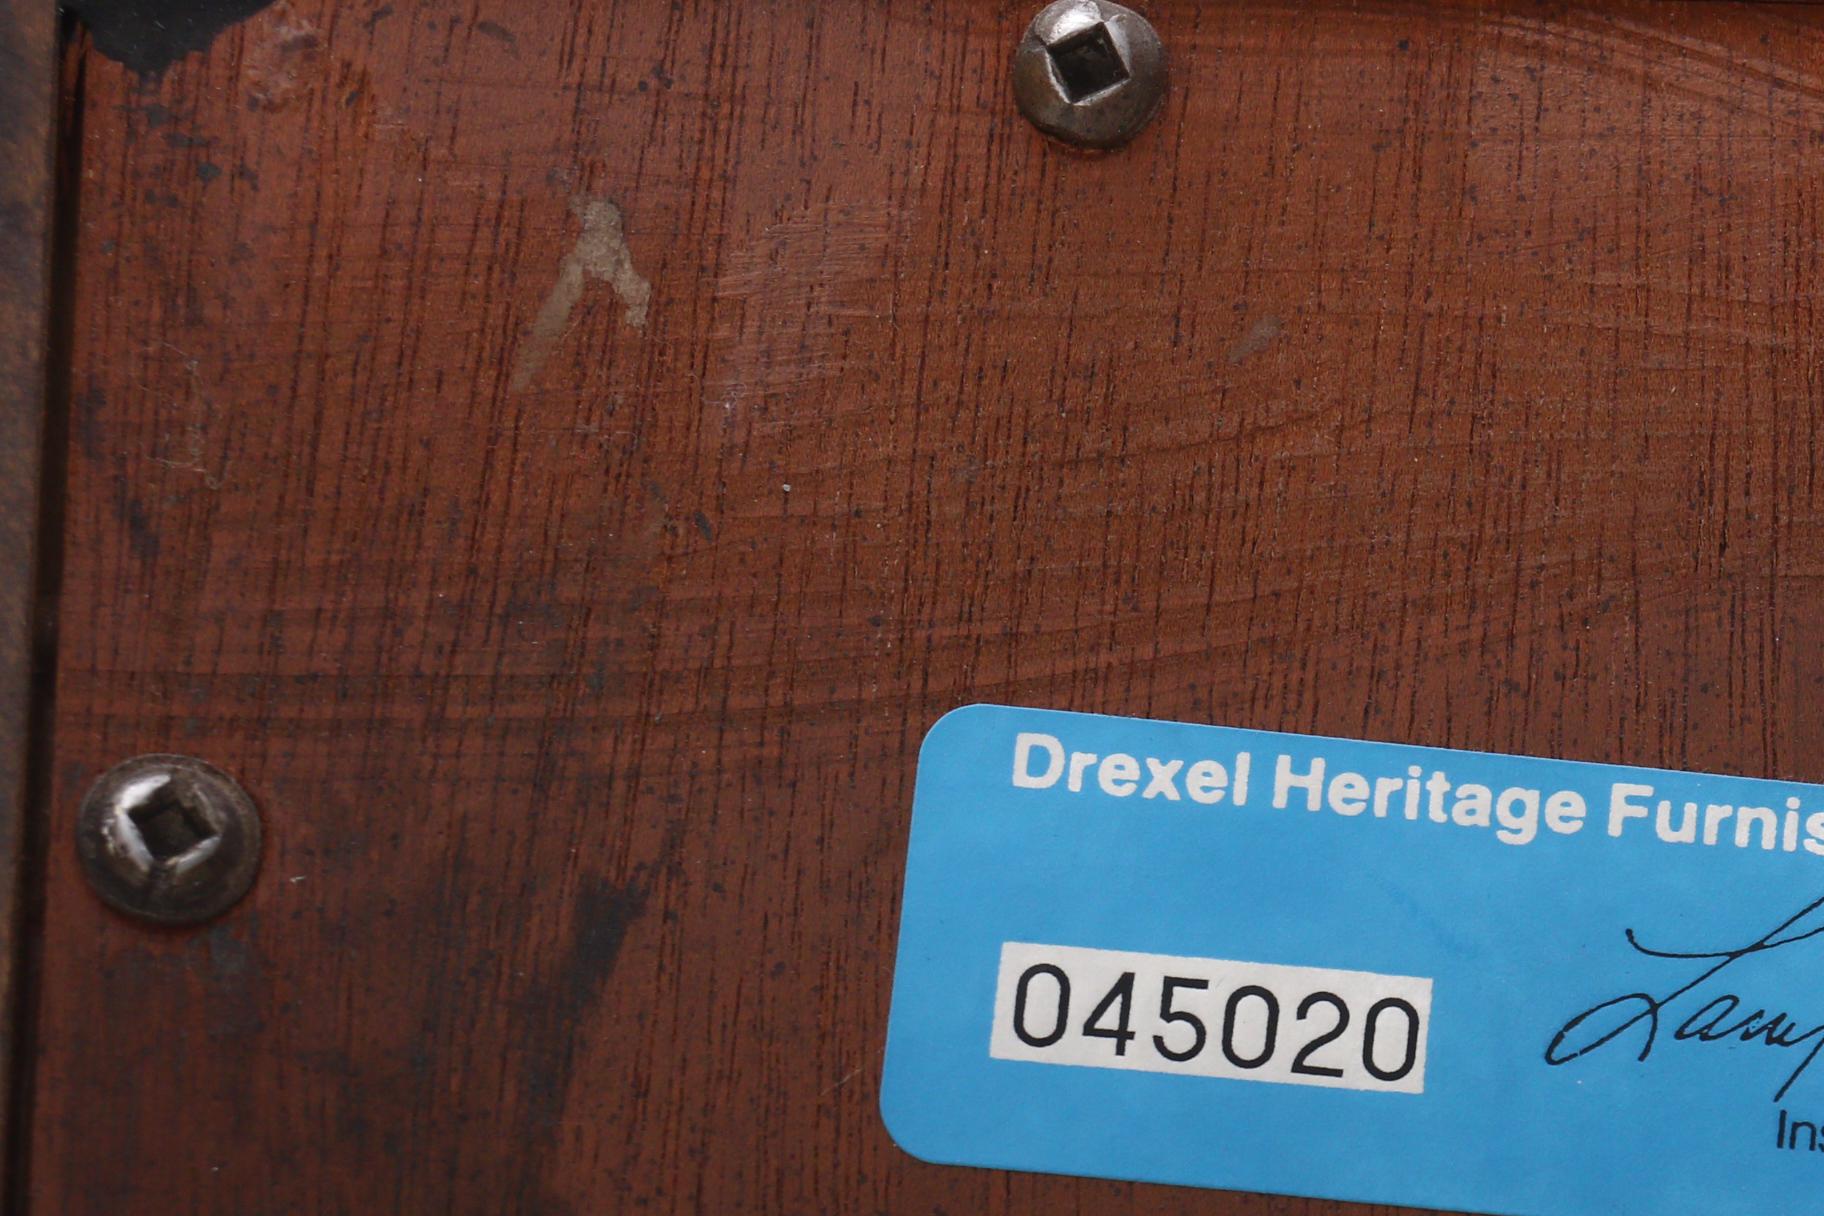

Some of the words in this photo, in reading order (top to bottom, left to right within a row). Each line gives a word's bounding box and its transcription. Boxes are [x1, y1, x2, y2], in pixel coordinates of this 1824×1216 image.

[1010, 731, 1253, 807] Drexel
[1271, 753, 1589, 847] Heritage
[1012, 962, 1421, 1083] 045020
